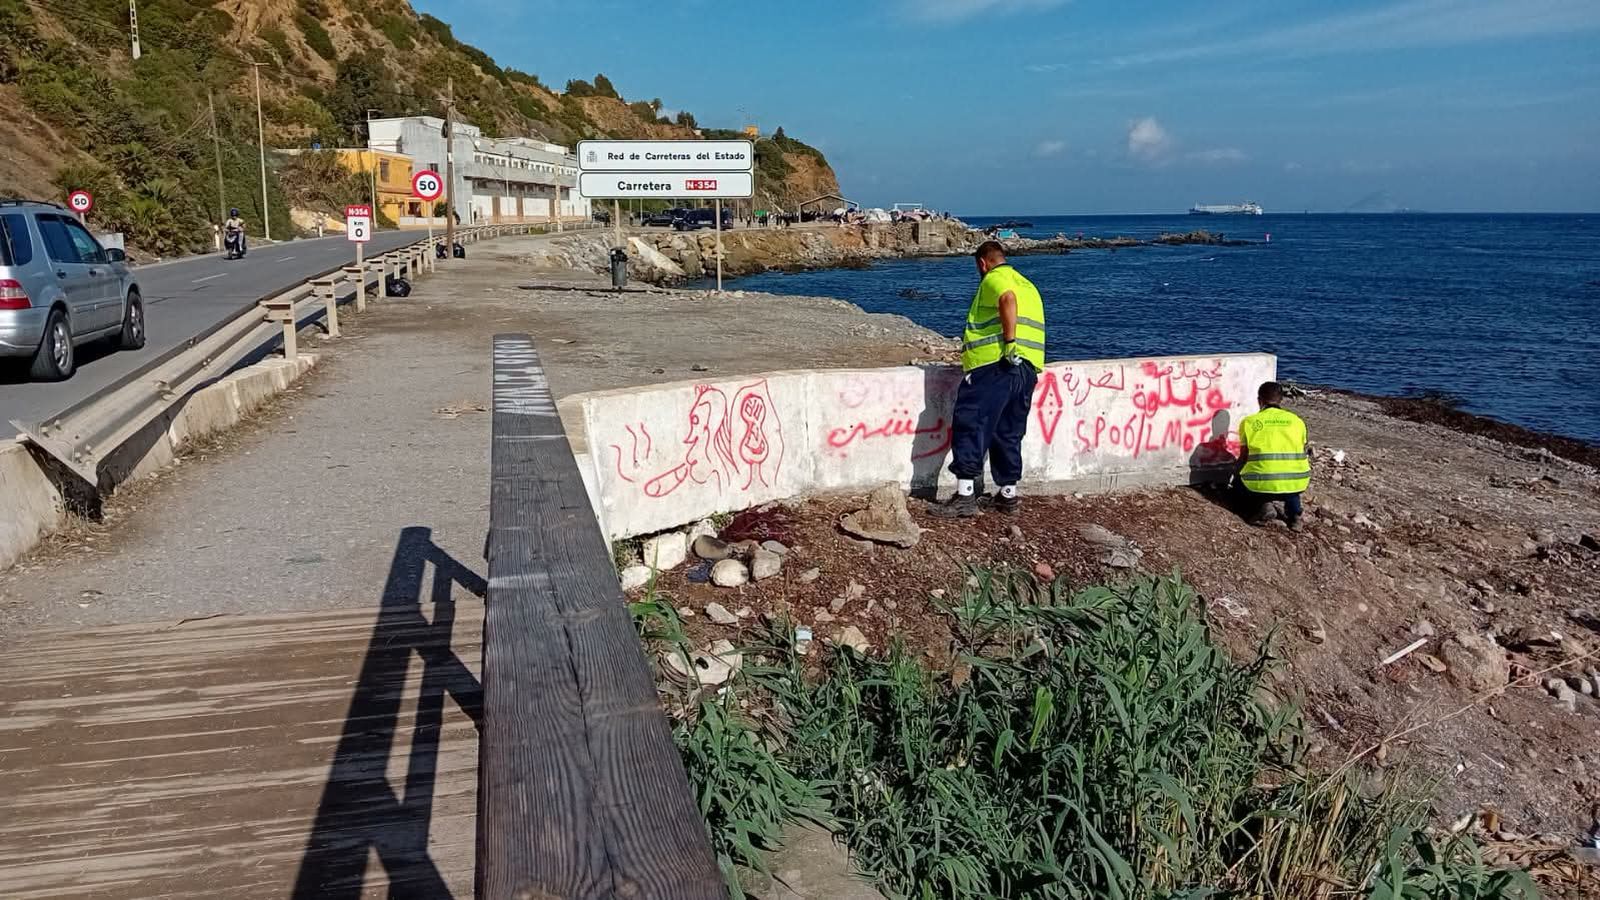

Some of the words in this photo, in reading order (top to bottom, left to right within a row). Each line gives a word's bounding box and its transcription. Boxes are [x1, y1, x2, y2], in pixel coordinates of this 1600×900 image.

[607, 152, 624, 160] Red
[629, 152, 640, 160] de
[645, 152, 691, 160] Carreteras
[696, 152, 710, 160] del
[715, 152, 745, 160] Estado
[419, 181, 436, 191] 50
[617, 181, 672, 191] Carretera
[686, 181, 716, 189] N-354
[74, 197, 87, 205] 50
[348, 208, 368, 216] N-354
[355, 228, 363, 237] 0
